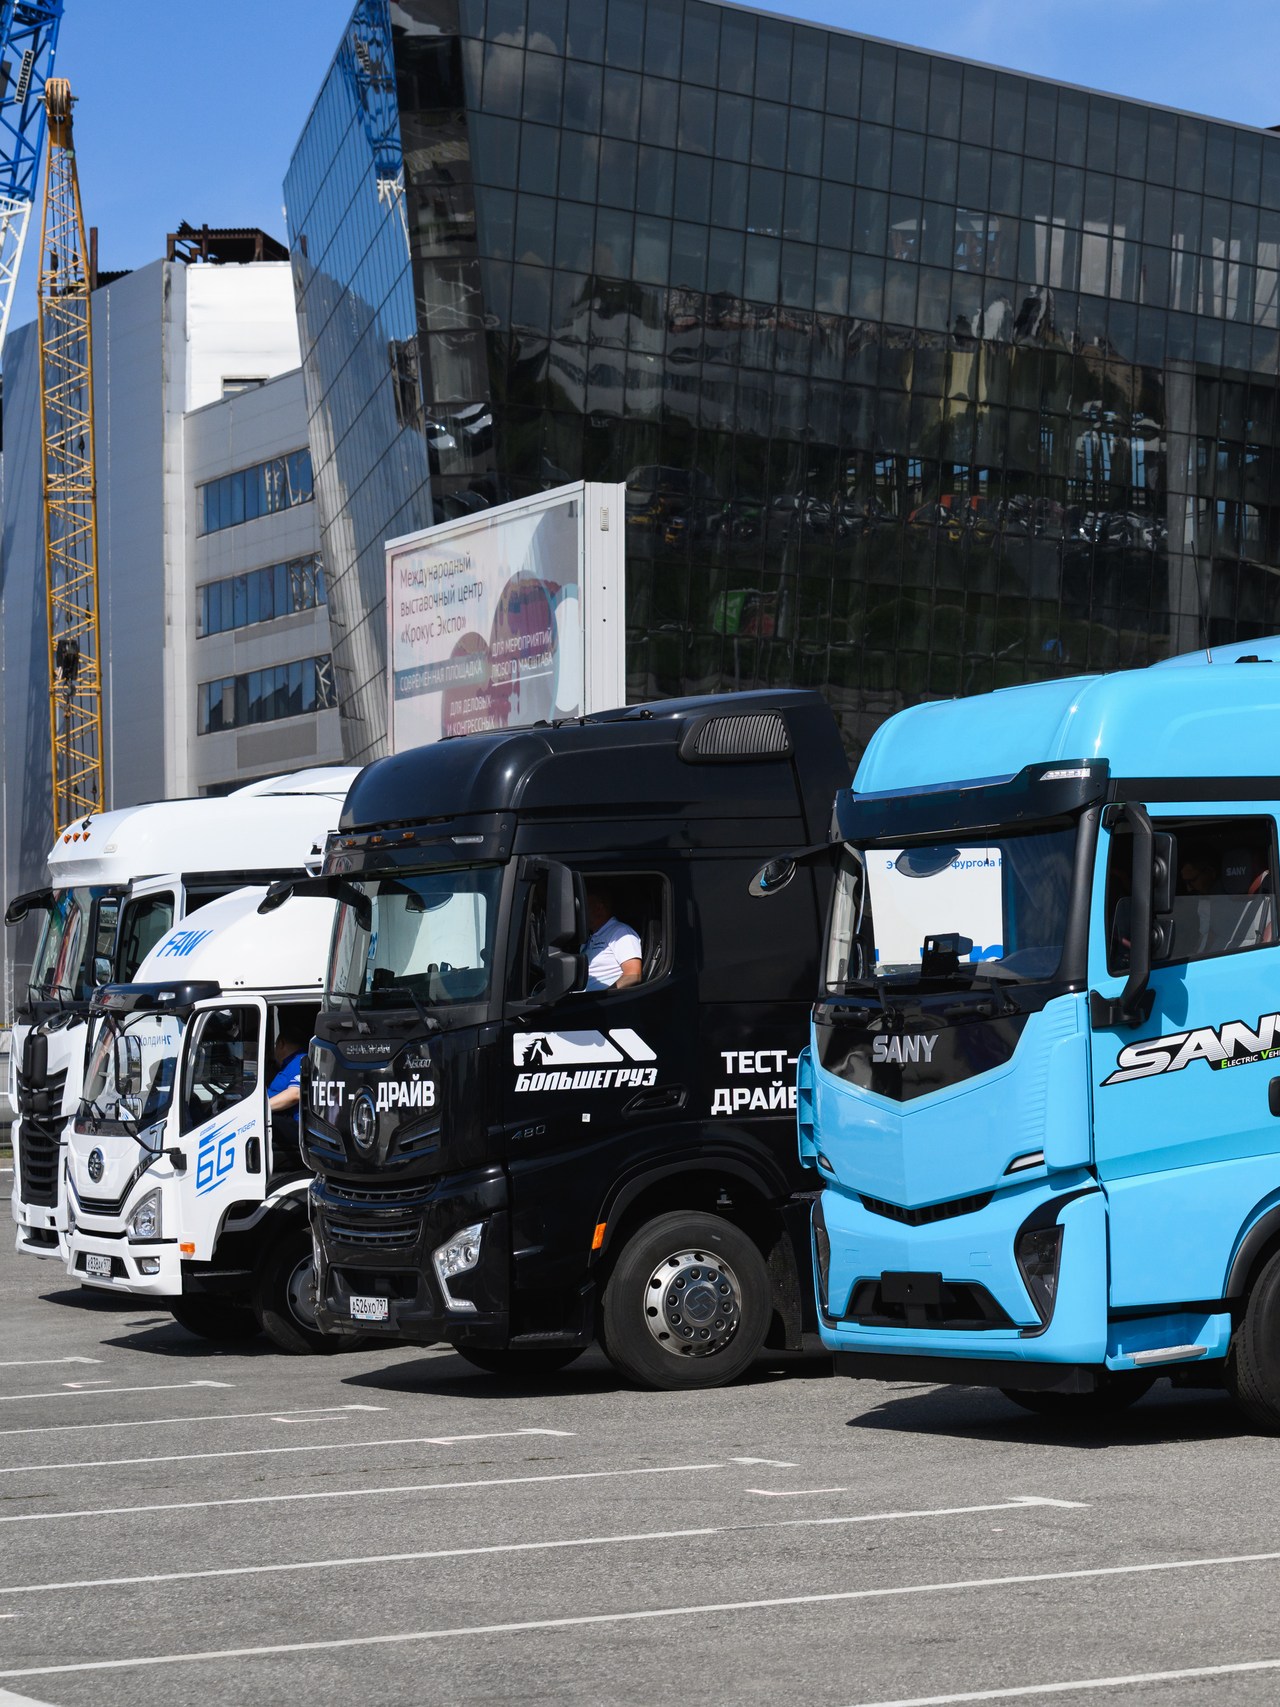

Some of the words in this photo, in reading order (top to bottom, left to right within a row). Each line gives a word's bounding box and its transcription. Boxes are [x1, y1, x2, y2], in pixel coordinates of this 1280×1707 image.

[400, 551, 472, 589] Международный
[400, 584, 456, 617] выставочный
[458, 581, 483, 604] центр
[401, 622, 435, 648] «Крокус
[437, 615, 467, 636] Экспо»
[491, 641, 505, 657] ДЛЯ
[505, 627, 553, 654] МЕРОПРИЯТИЙ
[400, 668, 445, 692] СОВРЕМЕННАЯ
[445, 659, 484, 681] ПЛОЩАДКА
[491, 659, 517, 678] ЛЮБОГО
[518, 651, 553, 672] МАСШТАБА
[450, 701, 463, 717] ДЛЯ
[463, 695, 492, 714] ДЕЛОВЫХ
[951, 859, 996, 870] фургона
[1225, 866, 1247, 877] SANY
[156, 930, 214, 957] FAW
[720, 1050, 798, 1074] ТЕСТ-
[872, 1034, 939, 1063] SANY
[1221, 1055, 1259, 1069] ELECTRIC
[375, 1073, 436, 1113] ДРАЙВ
[514, 1067, 658, 1093] БОЛЬШЕГРУЗ
[196, 1131, 237, 1190] 6G
